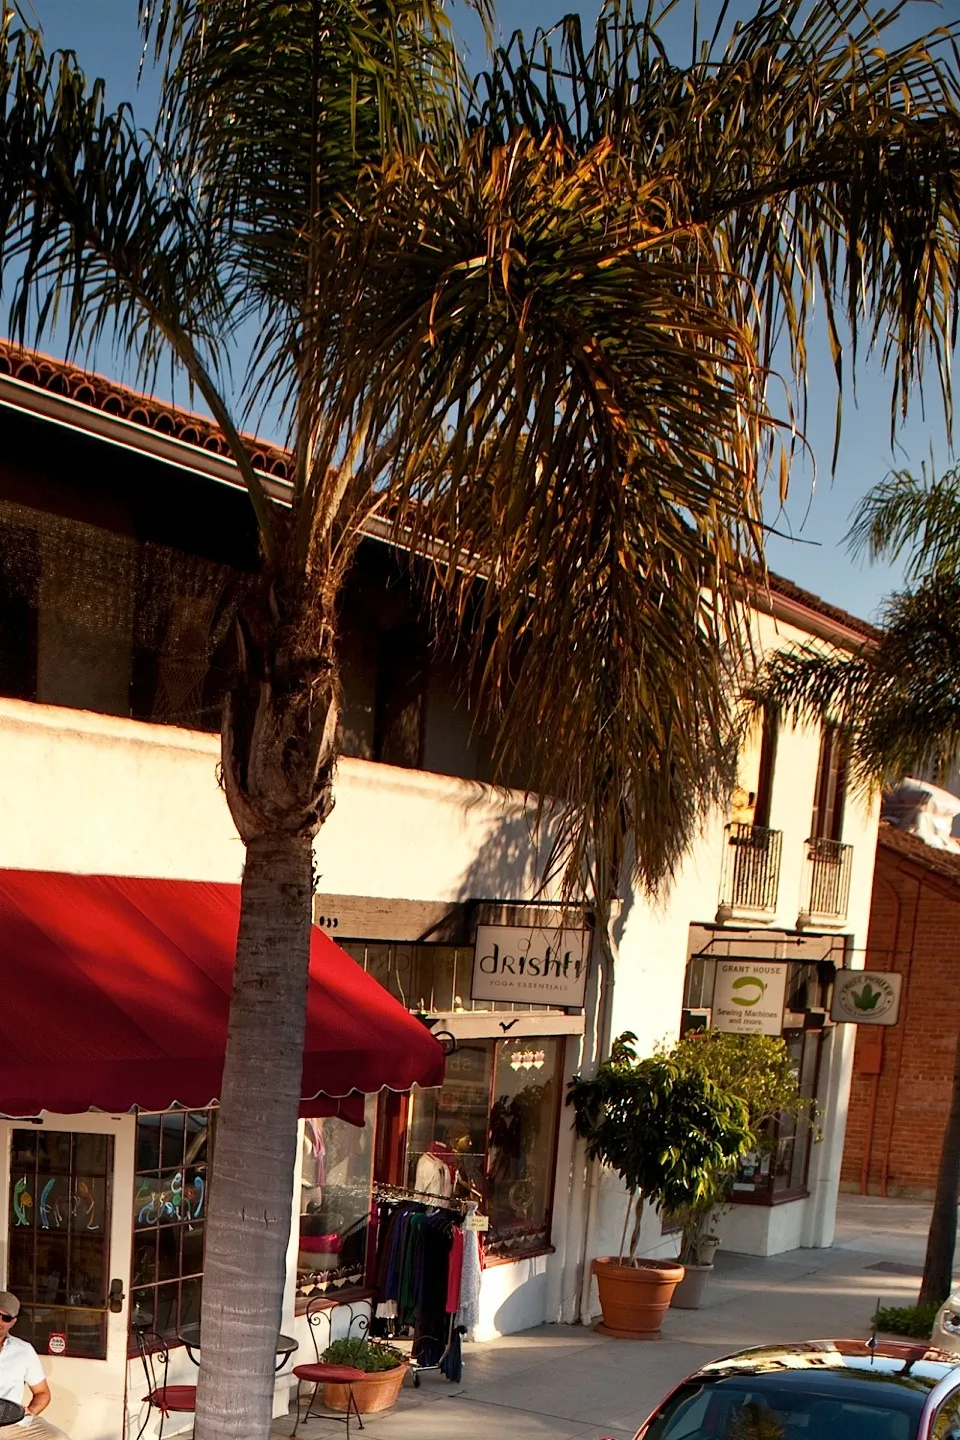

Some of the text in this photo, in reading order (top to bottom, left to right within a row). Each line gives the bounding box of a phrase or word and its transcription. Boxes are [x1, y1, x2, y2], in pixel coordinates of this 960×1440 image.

[722, 965, 750, 973] GRANT
[518, 981, 568, 991] ESSENTIALS
[717, 1008, 778, 1018] Sewing Machines
